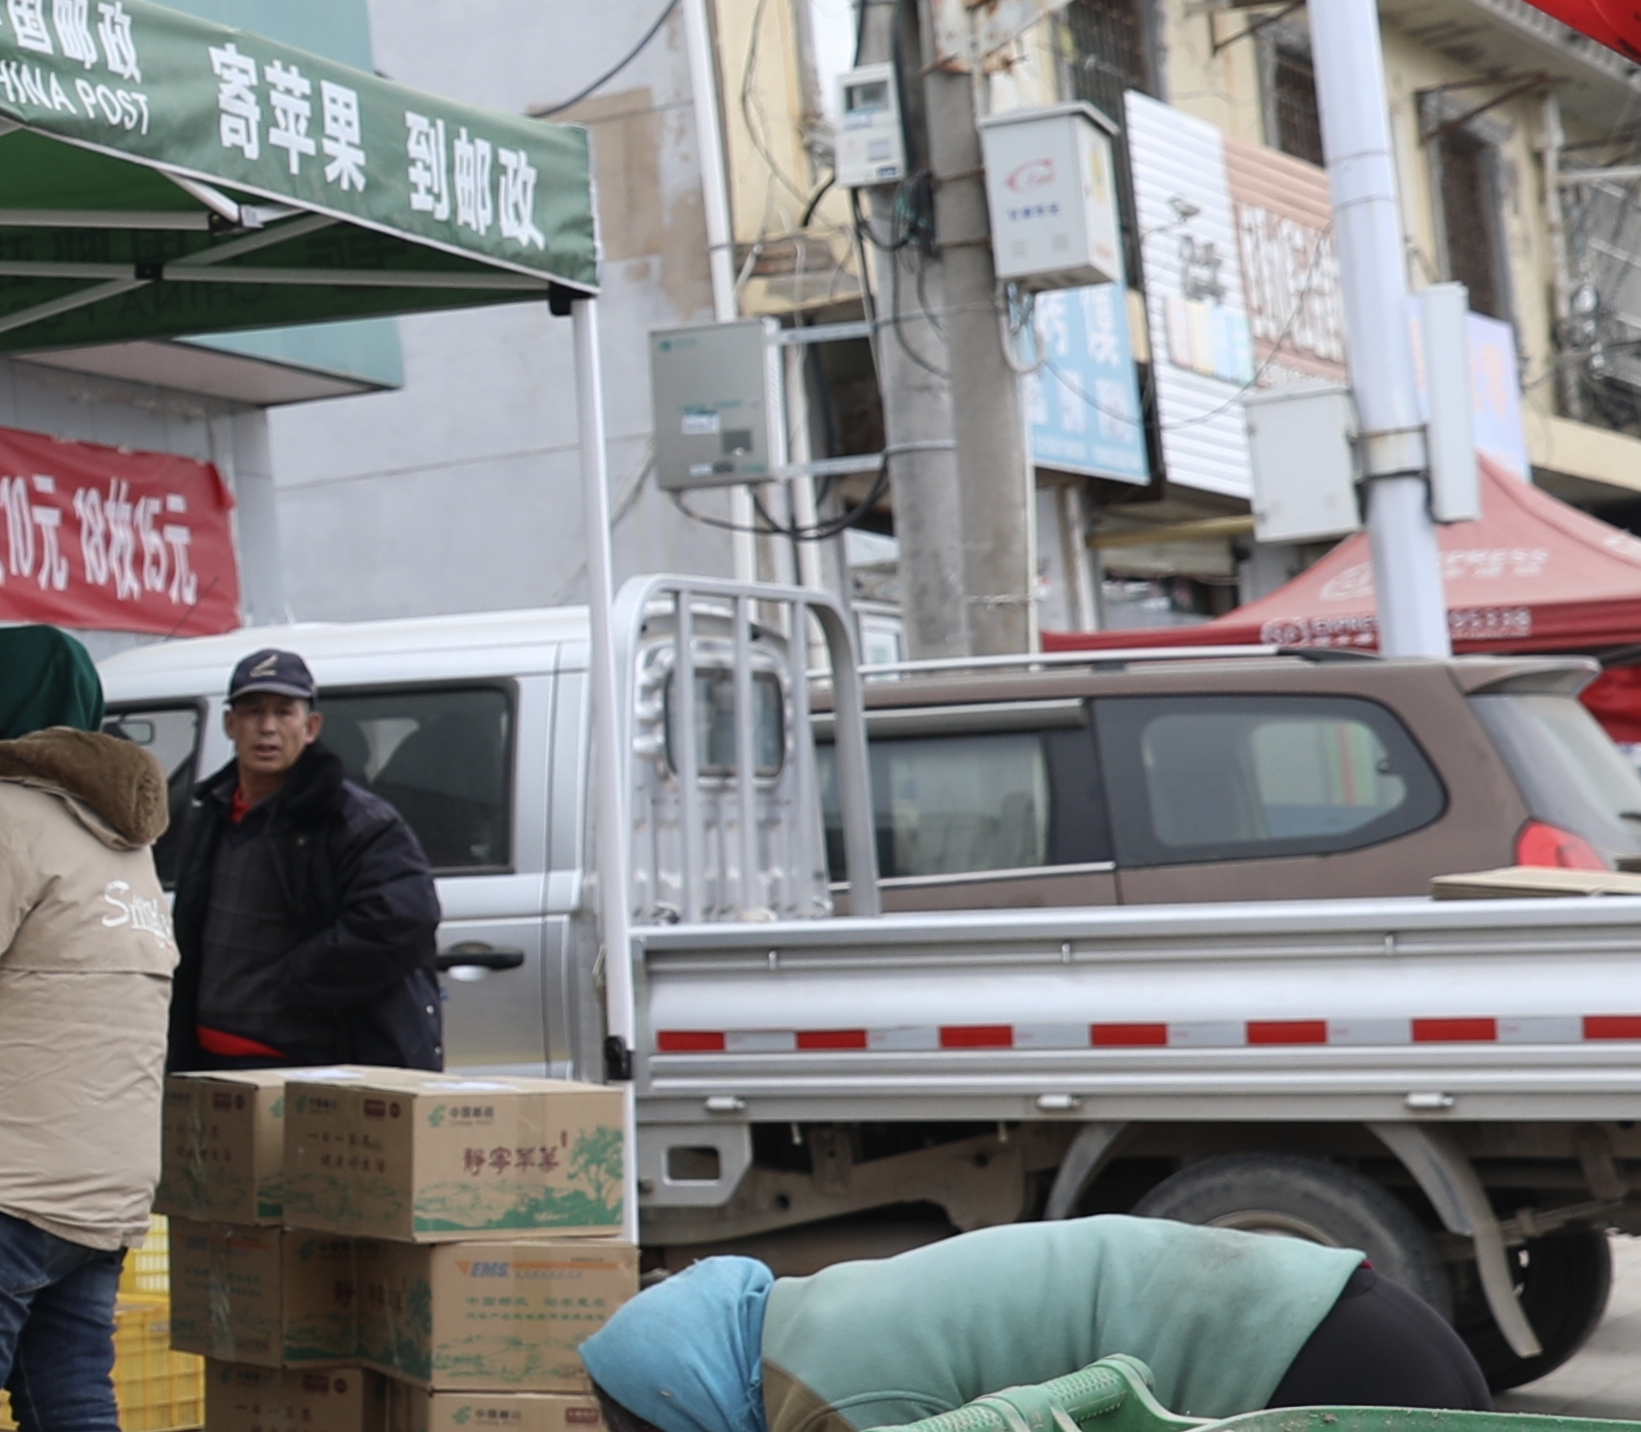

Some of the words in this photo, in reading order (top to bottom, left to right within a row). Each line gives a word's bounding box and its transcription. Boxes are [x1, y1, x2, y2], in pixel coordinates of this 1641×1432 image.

[82, 83, 152, 137] POST
[208, 39, 370, 196] 寄苹果
[404, 108, 548, 252] 到邮政
